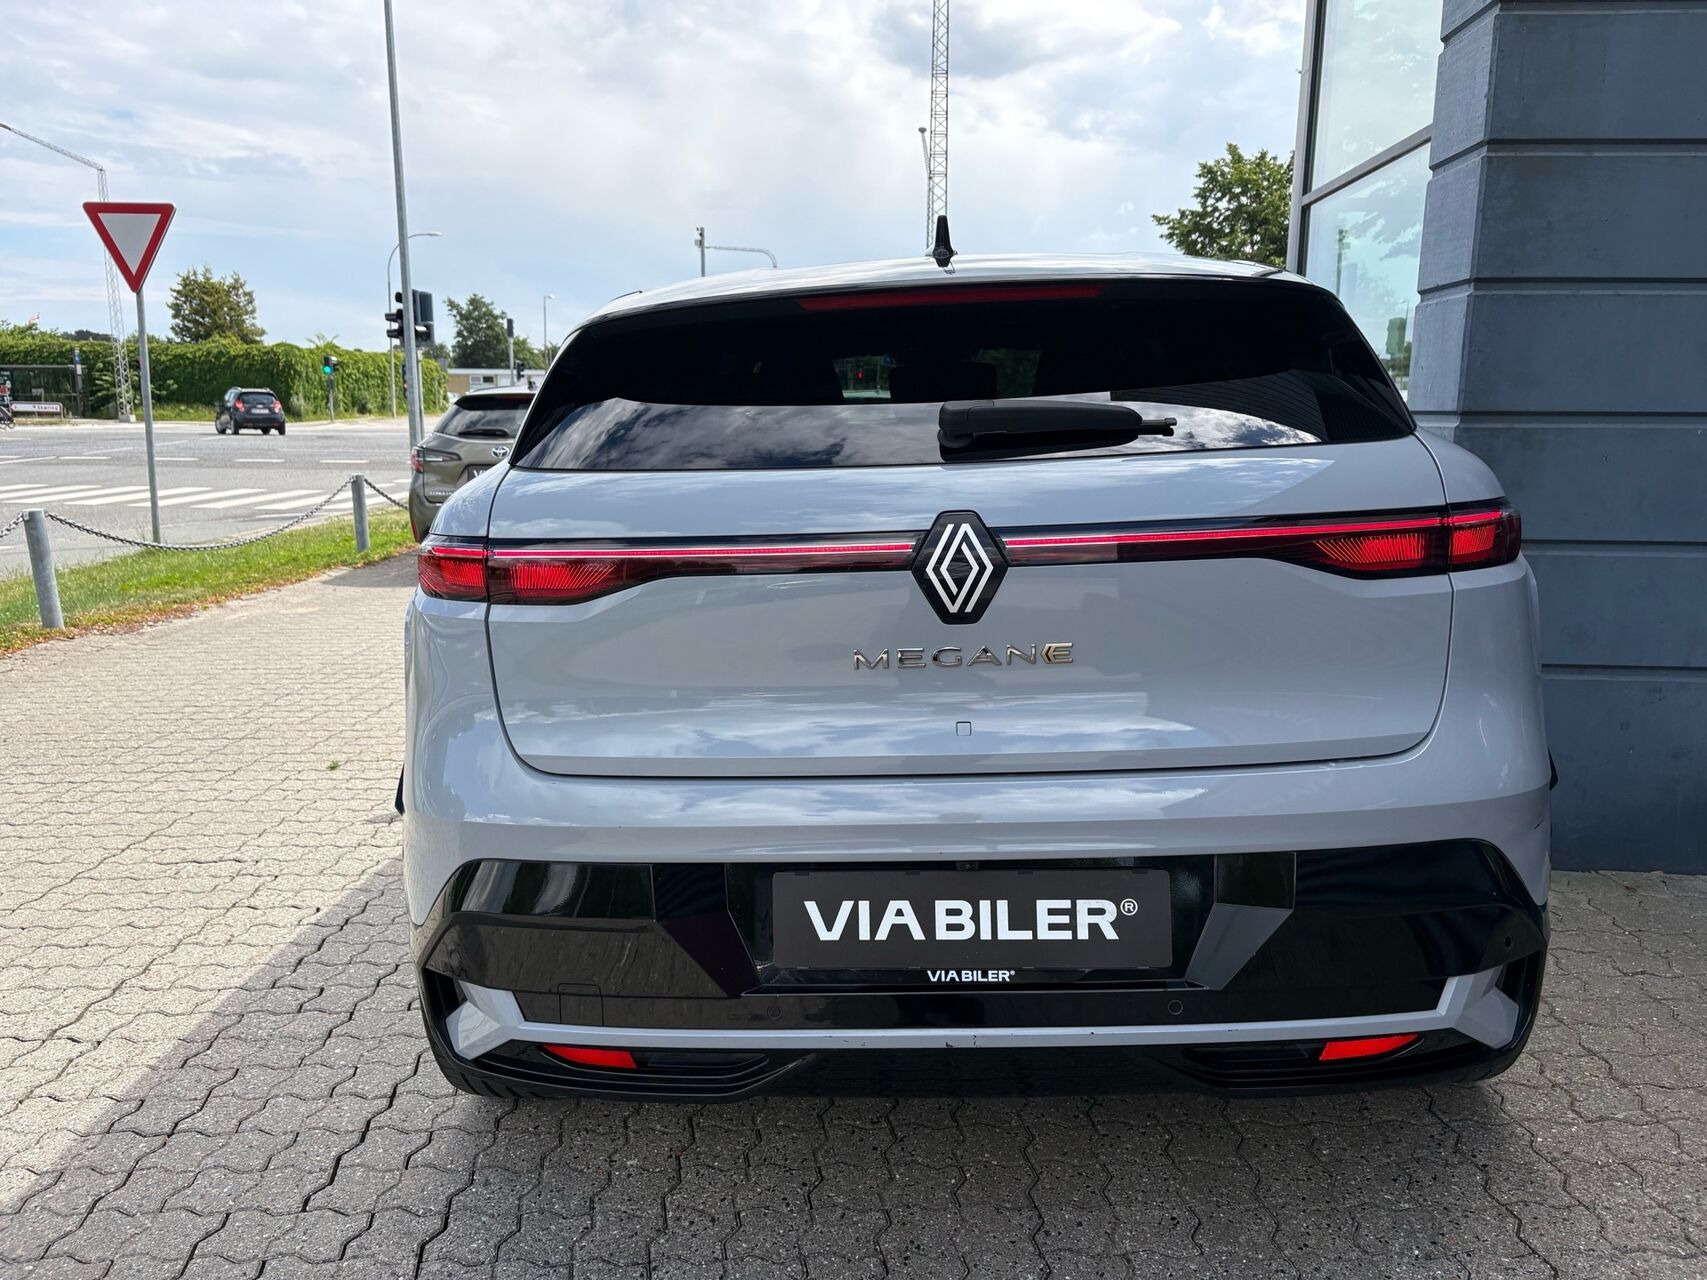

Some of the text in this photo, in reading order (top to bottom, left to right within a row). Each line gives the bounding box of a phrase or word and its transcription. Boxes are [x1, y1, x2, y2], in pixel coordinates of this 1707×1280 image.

[853, 642, 1074, 670] MEGANE
[803, 899, 926, 941] VIA
[926, 970, 960, 982] VIA
